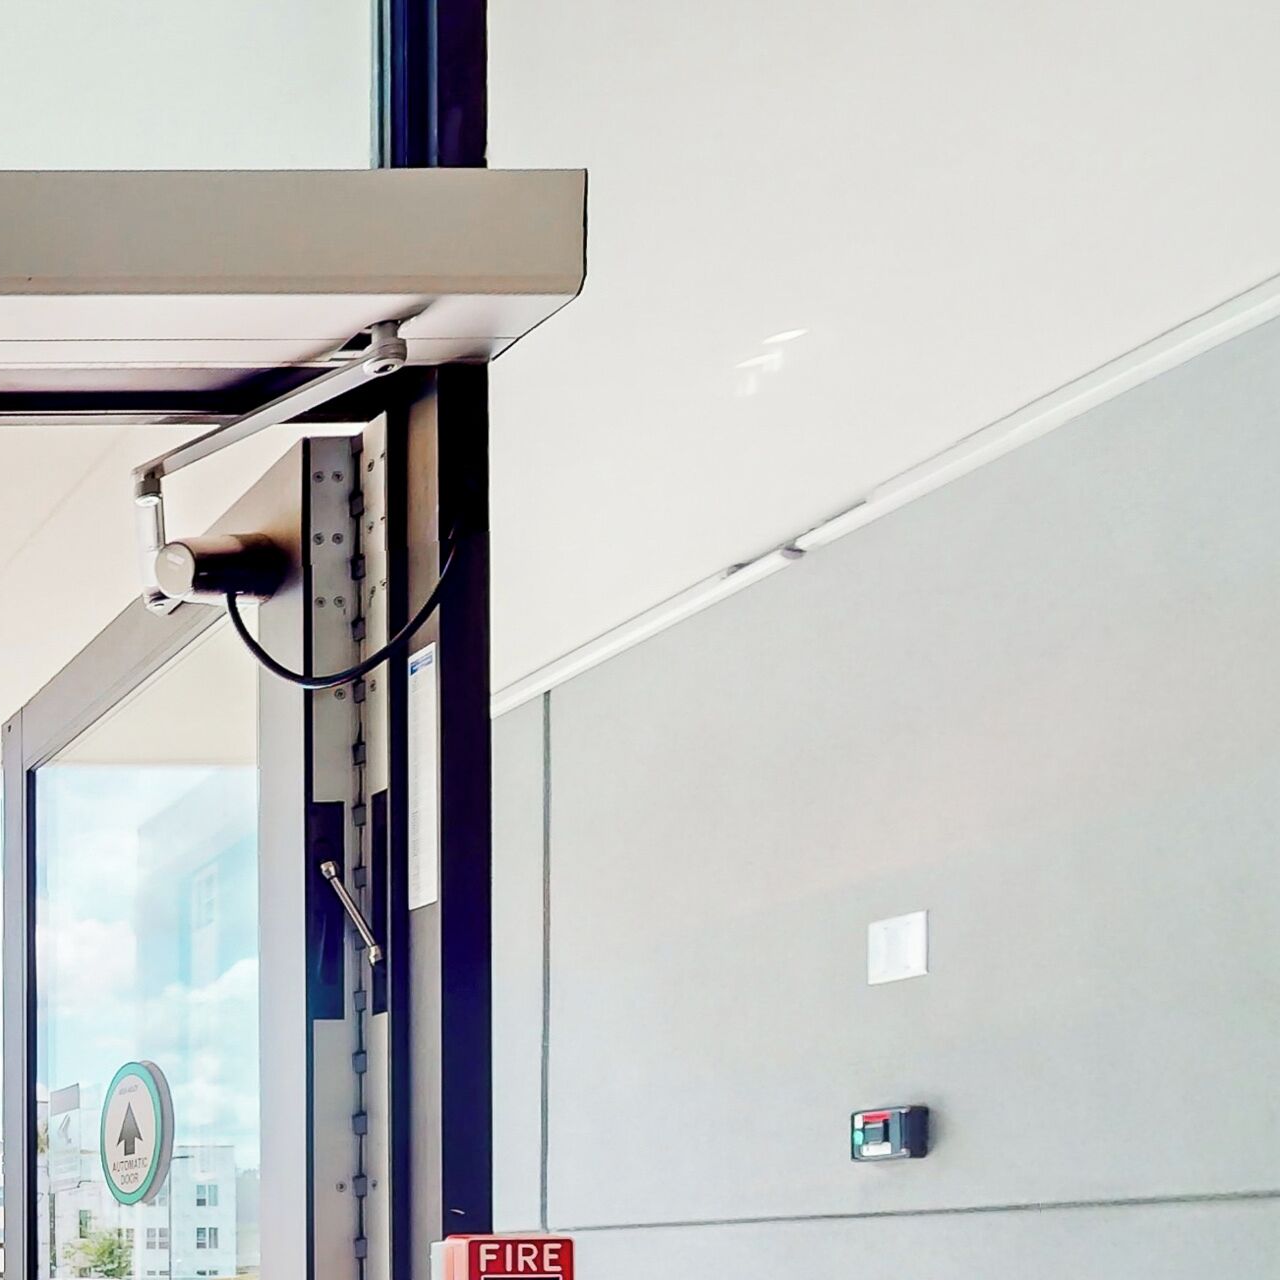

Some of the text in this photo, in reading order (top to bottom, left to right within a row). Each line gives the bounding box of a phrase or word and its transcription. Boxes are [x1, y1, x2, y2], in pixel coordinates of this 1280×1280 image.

[112, 1156, 148, 1172] AUTOMATIC
[120, 1172, 139, 1185] DOOR
[480, 1243, 562, 1272] FIRE
